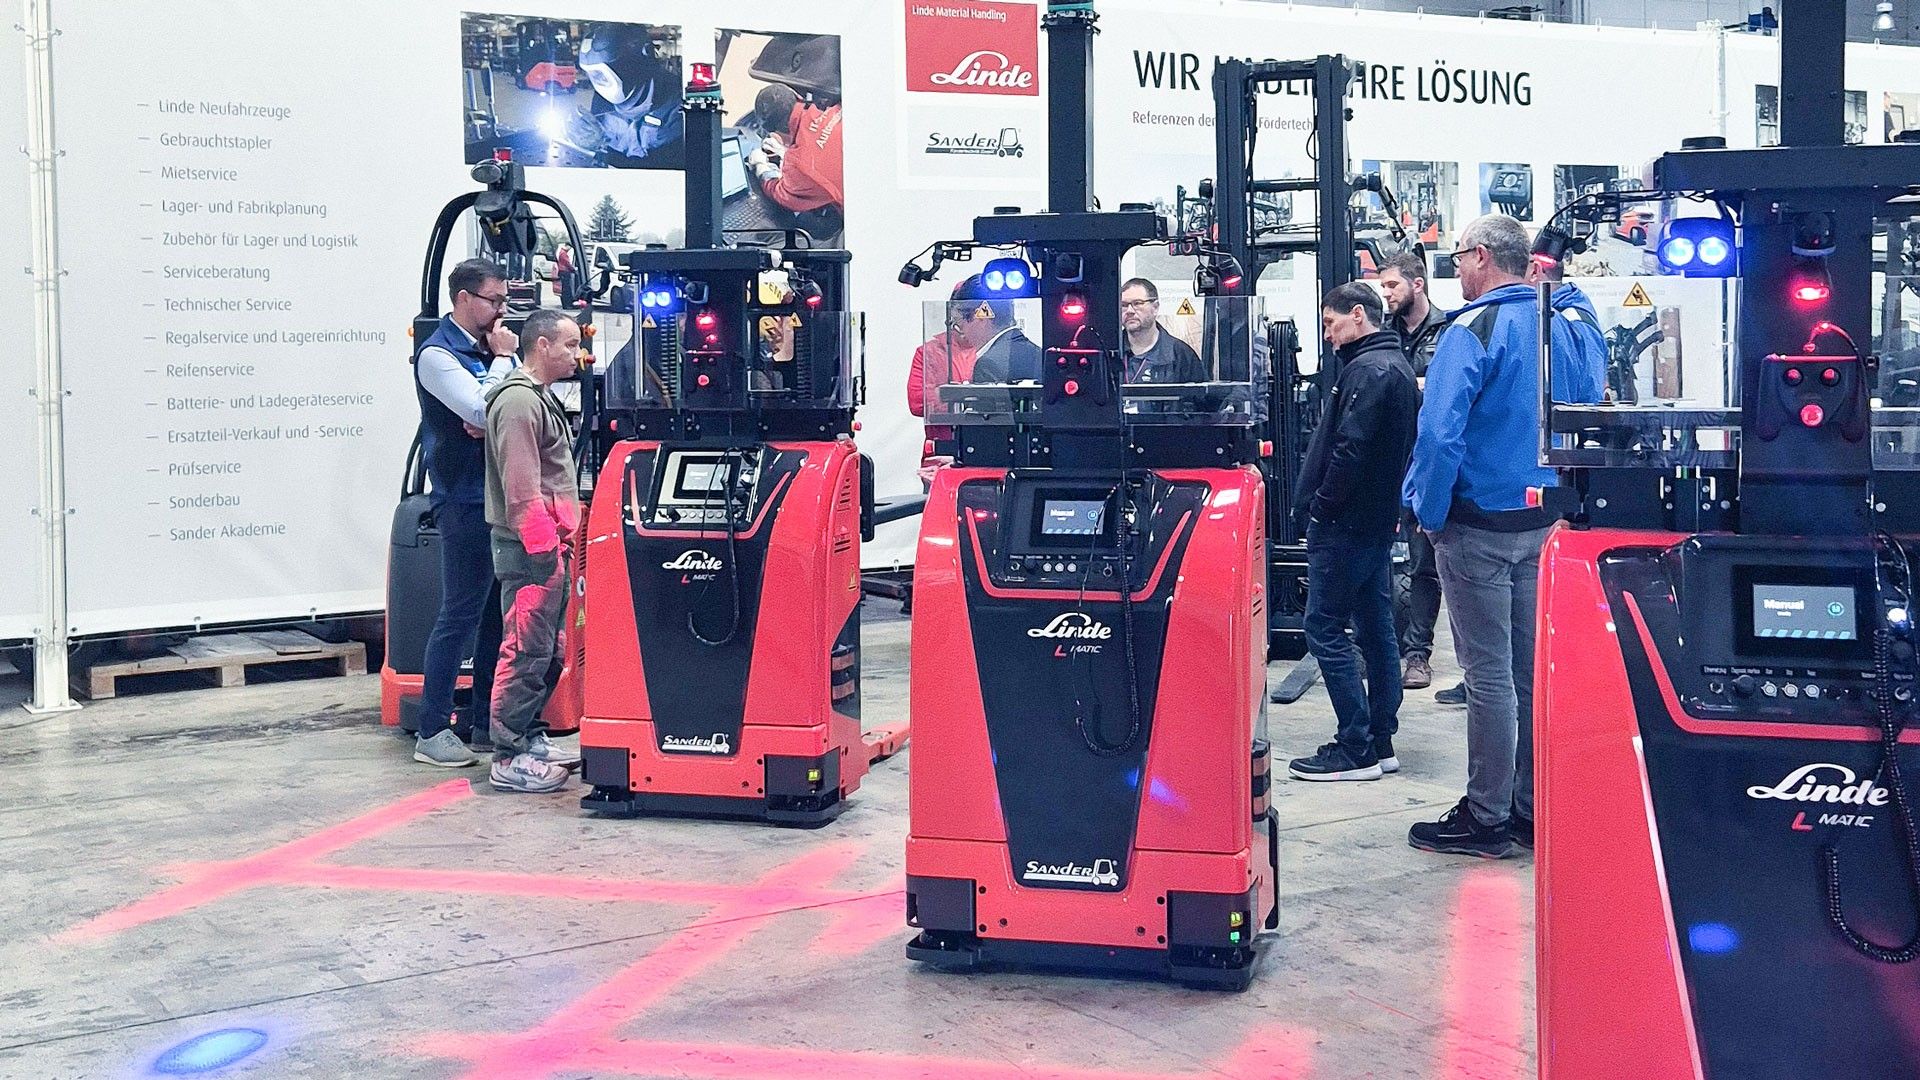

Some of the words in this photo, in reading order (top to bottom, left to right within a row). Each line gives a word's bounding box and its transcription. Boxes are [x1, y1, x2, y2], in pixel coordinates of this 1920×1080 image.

[912, 5, 935, 16] Linde
[936, 6, 970, 18] Material
[971, 8, 1007, 22] Handling
[930, 50, 1033, 88] Linde
[1133, 50, 1200, 90] WIR
[1349, 62, 1405, 101] HRE
[1418, 60, 1531, 106] LÖSUNG
[158, 100, 195, 114] Linde
[200, 101, 291, 121] Neufahrzeuge
[1132, 111, 1195, 127] Referenzen
[1259, 117, 1313, 131] Fördertech
[160, 132, 272, 152] Gebrauchtstapler
[161, 166, 238, 181] Mietservice
[162, 199, 204, 216] Lager-
[208, 200, 233, 213] und
[238, 200, 327, 218] Fabrikplanung
[163, 232, 217, 246] Zubehör
[222, 232, 239, 246] für
[243, 233, 278, 250] Lager
[283, 234, 307, 247] und
[312, 234, 358, 251] Logistik
[164, 265, 270, 282] Serviceberatung
[164, 297, 241, 312] Technischer
[246, 298, 292, 311] Service
[165, 330, 249, 348] Regalservice
[253, 330, 277, 343] und
[282, 329, 386, 346] Lagereinrichtung
[166, 363, 255, 377] Reifenservice
[167, 395, 225, 411] Batterie-
[230, 395, 254, 409] und
[259, 393, 373, 410] Ladegeräteservice
[168, 426, 281, 444] Ersatzteil-Verkauf
[285, 425, 309, 439] und
[314, 425, 364, 438] -Service
[168, 461, 241, 476] Prüfservice
[169, 494, 240, 509] Sonderbau
[170, 527, 215, 541] Sander
[220, 522, 286, 538] Akademie
[662, 550, 723, 570] Linde
[1027, 612, 1112, 640] Linde
[1054, 645, 1067, 657] L
[1746, 763, 1889, 806] Linde
[1791, 811, 1813, 831] L
[1818, 813, 1874, 827] MATIC
